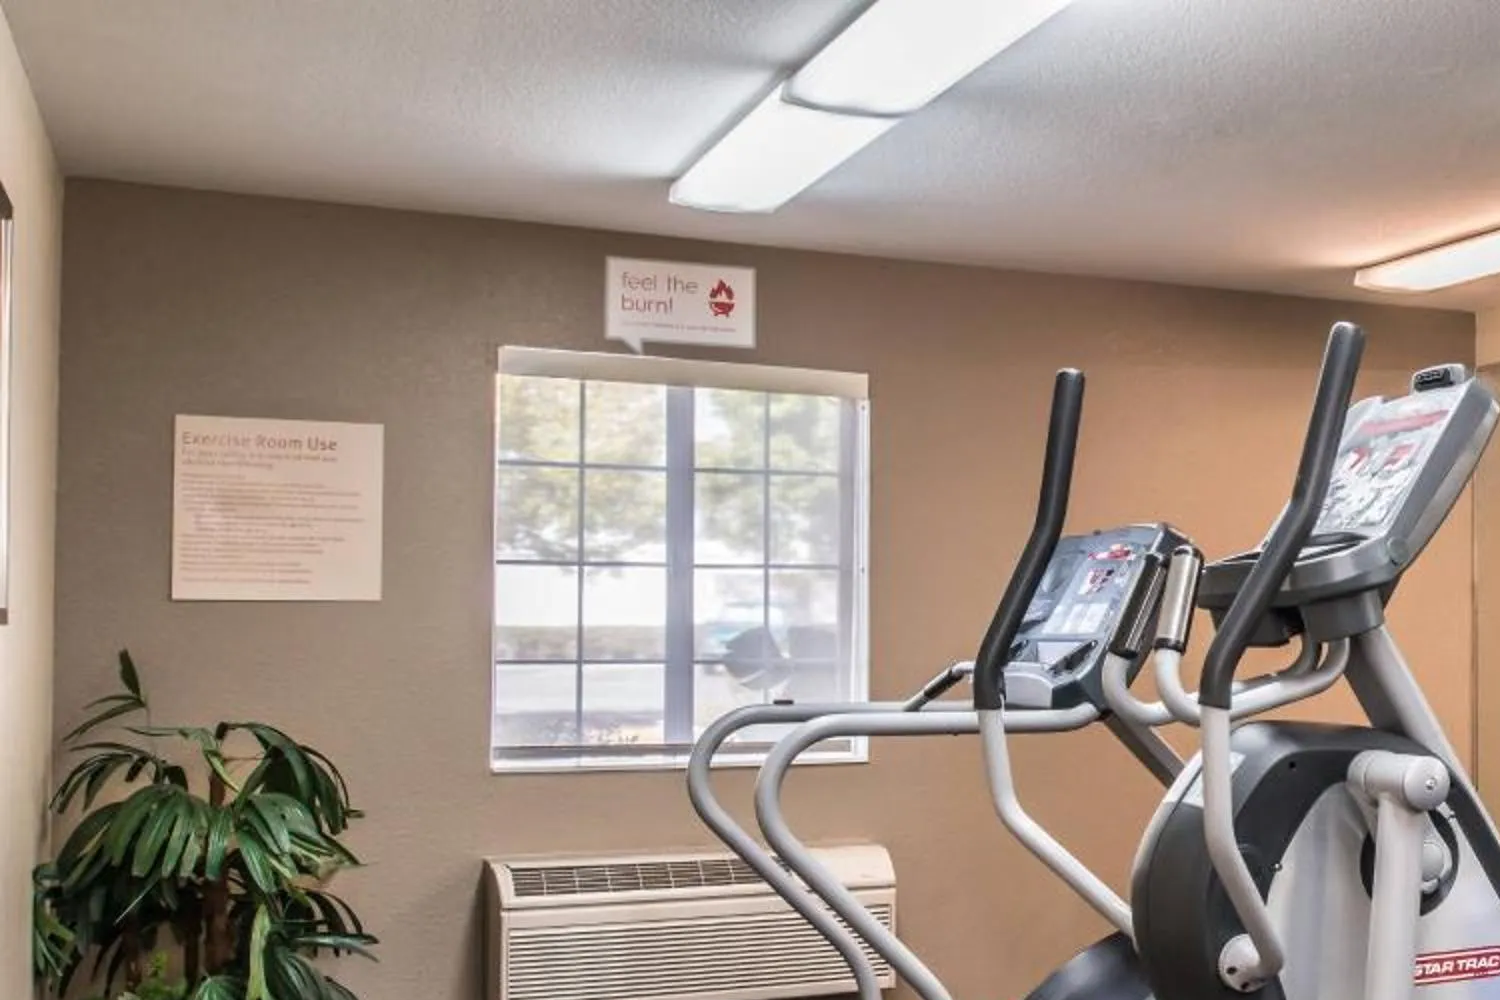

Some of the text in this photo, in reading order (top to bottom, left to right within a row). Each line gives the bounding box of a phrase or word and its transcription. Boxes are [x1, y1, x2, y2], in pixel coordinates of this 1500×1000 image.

[621, 271, 698, 294] feel the
[621, 294, 673, 314] burn!
[181, 431, 338, 451] Exercise Room Use
[1415, 961, 1454, 977] STAR
